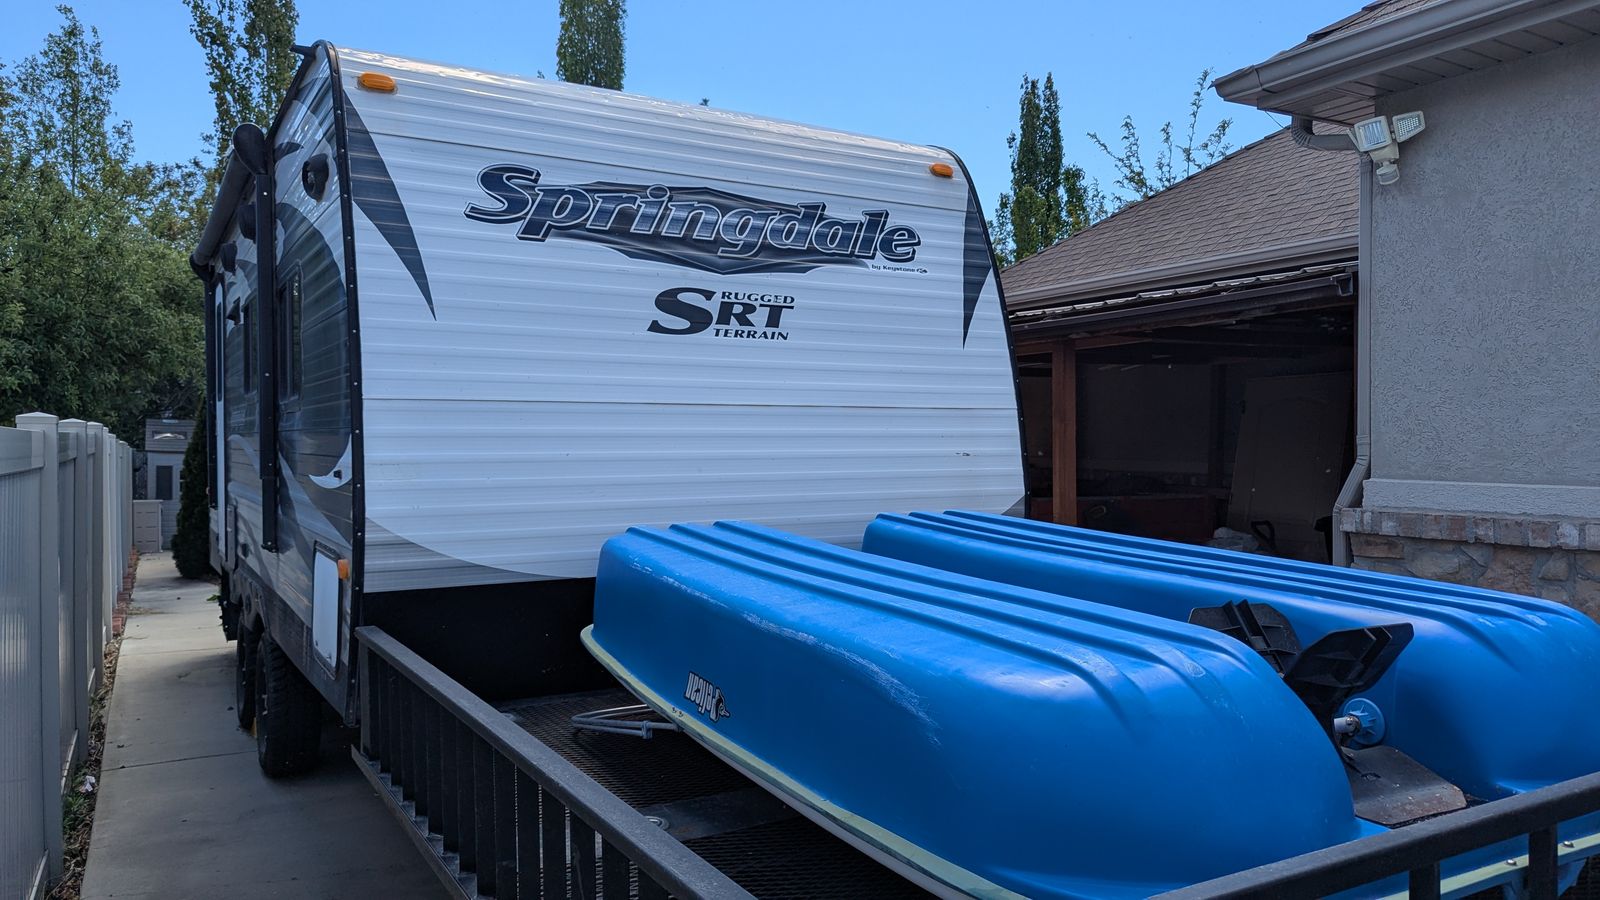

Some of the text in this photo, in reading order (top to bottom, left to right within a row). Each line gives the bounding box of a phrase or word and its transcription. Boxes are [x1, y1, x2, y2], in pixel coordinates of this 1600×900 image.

[464, 163, 922, 263] Springdale
[646, 287, 795, 335] SRT
[721, 291, 795, 304] RUGGED
[713, 328, 789, 341] TERRAIN
[684, 671, 725, 722] Pelican
